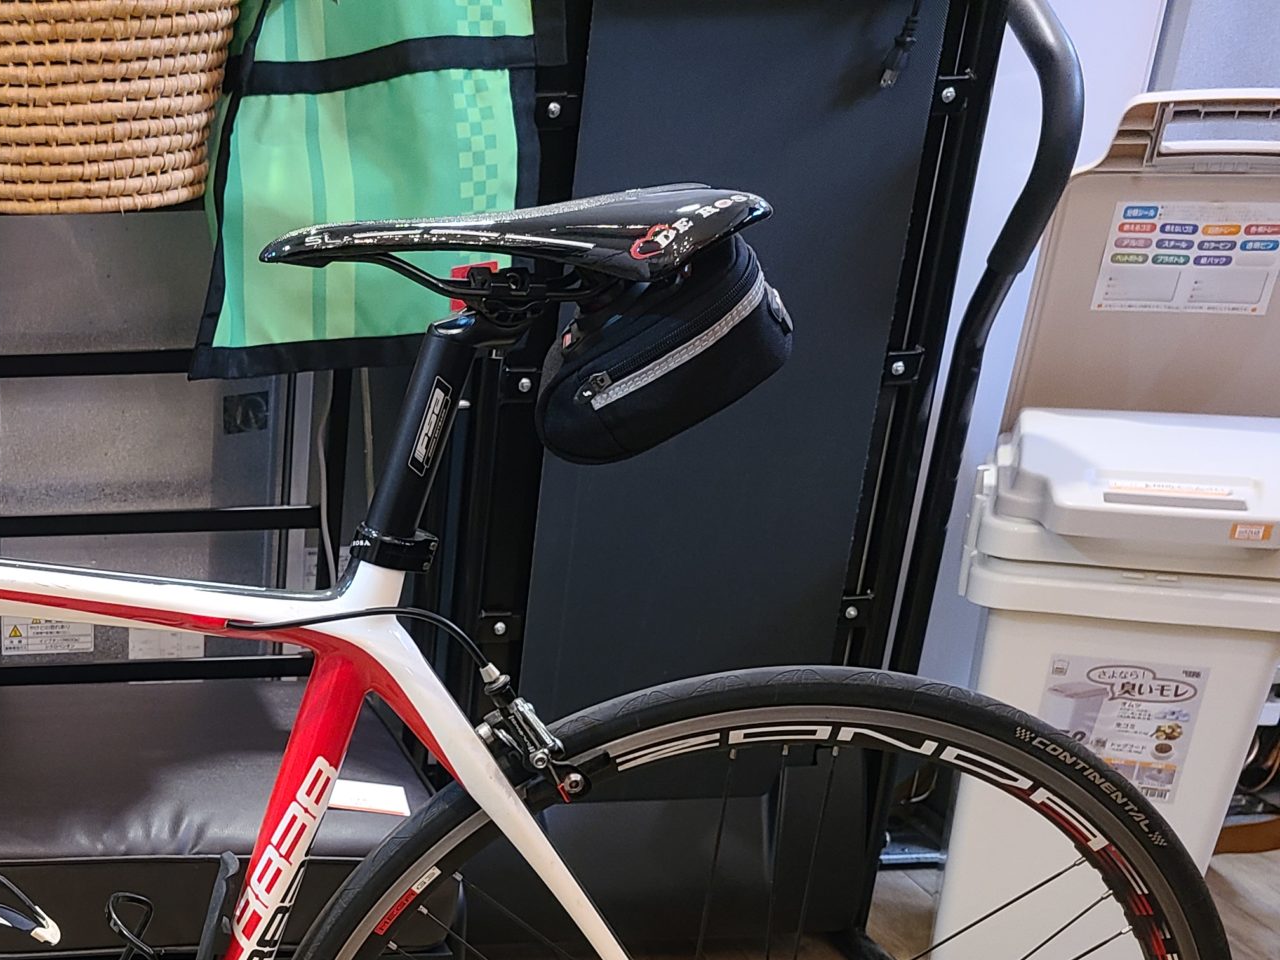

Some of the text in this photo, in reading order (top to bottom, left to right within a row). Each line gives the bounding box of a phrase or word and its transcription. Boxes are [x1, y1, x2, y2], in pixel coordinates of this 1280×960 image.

[1118, 681, 1189, 698] 臭いモレ
[1031, 737, 1151, 835] CONTINENTAL
